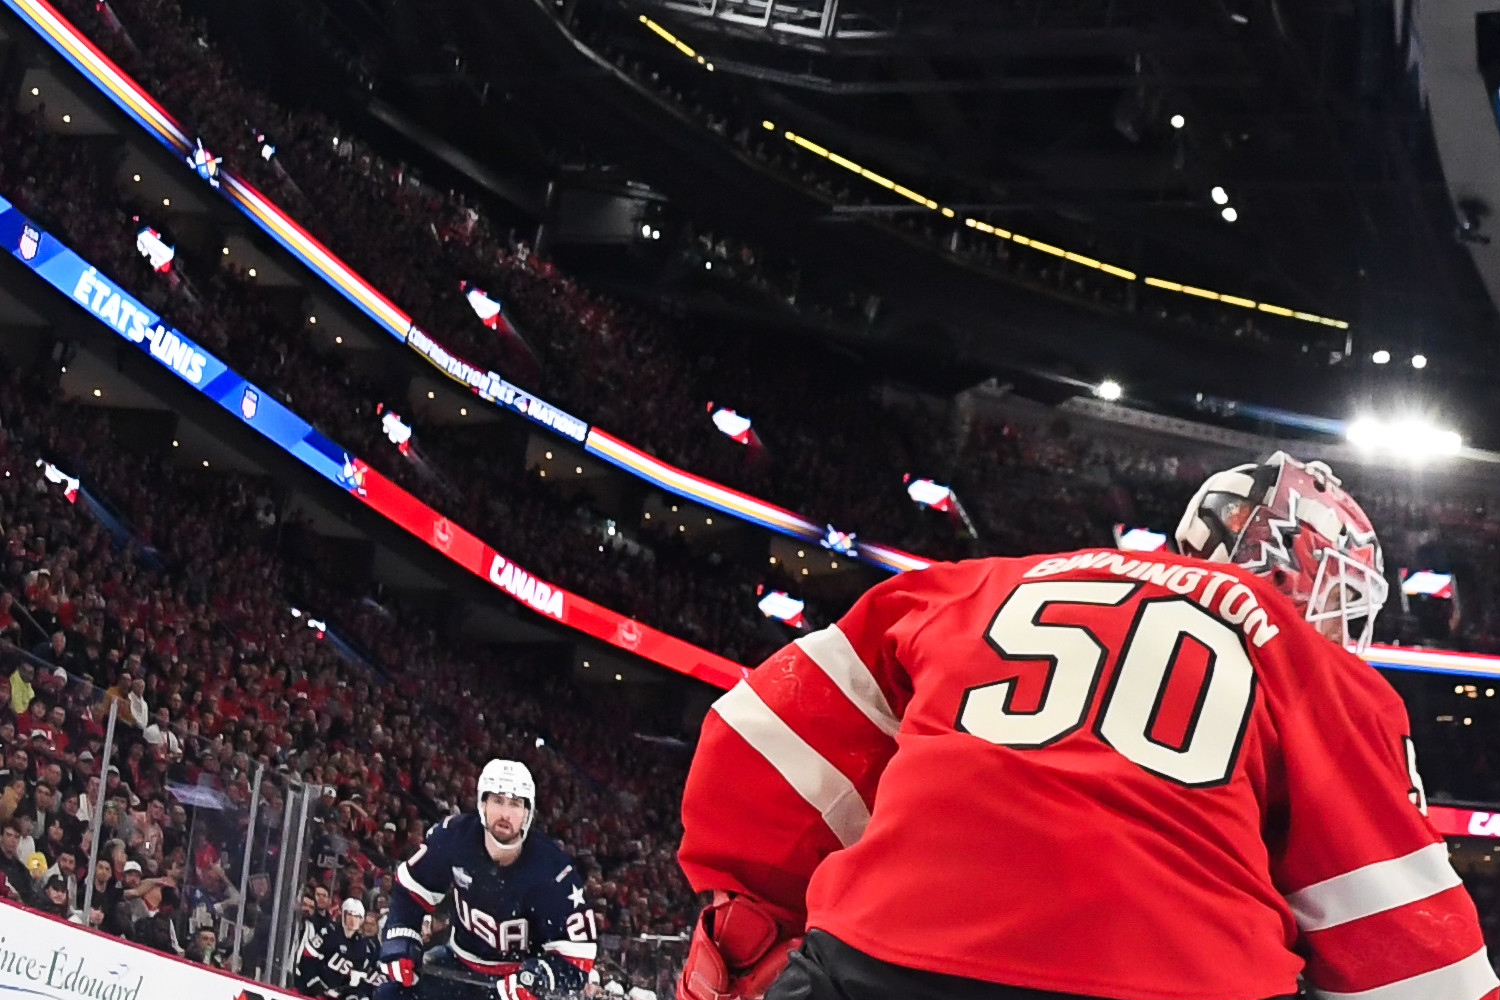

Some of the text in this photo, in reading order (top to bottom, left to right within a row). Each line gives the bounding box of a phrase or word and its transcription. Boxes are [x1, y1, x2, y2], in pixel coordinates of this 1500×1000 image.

[73, 265, 206, 383] ÉTATS-UNIS
[489, 554, 564, 618] CANADA
[956, 579, 1257, 788] 50
[453, 887, 529, 951] USA
[566, 909, 598, 941] 21
[328, 952, 354, 975] US
